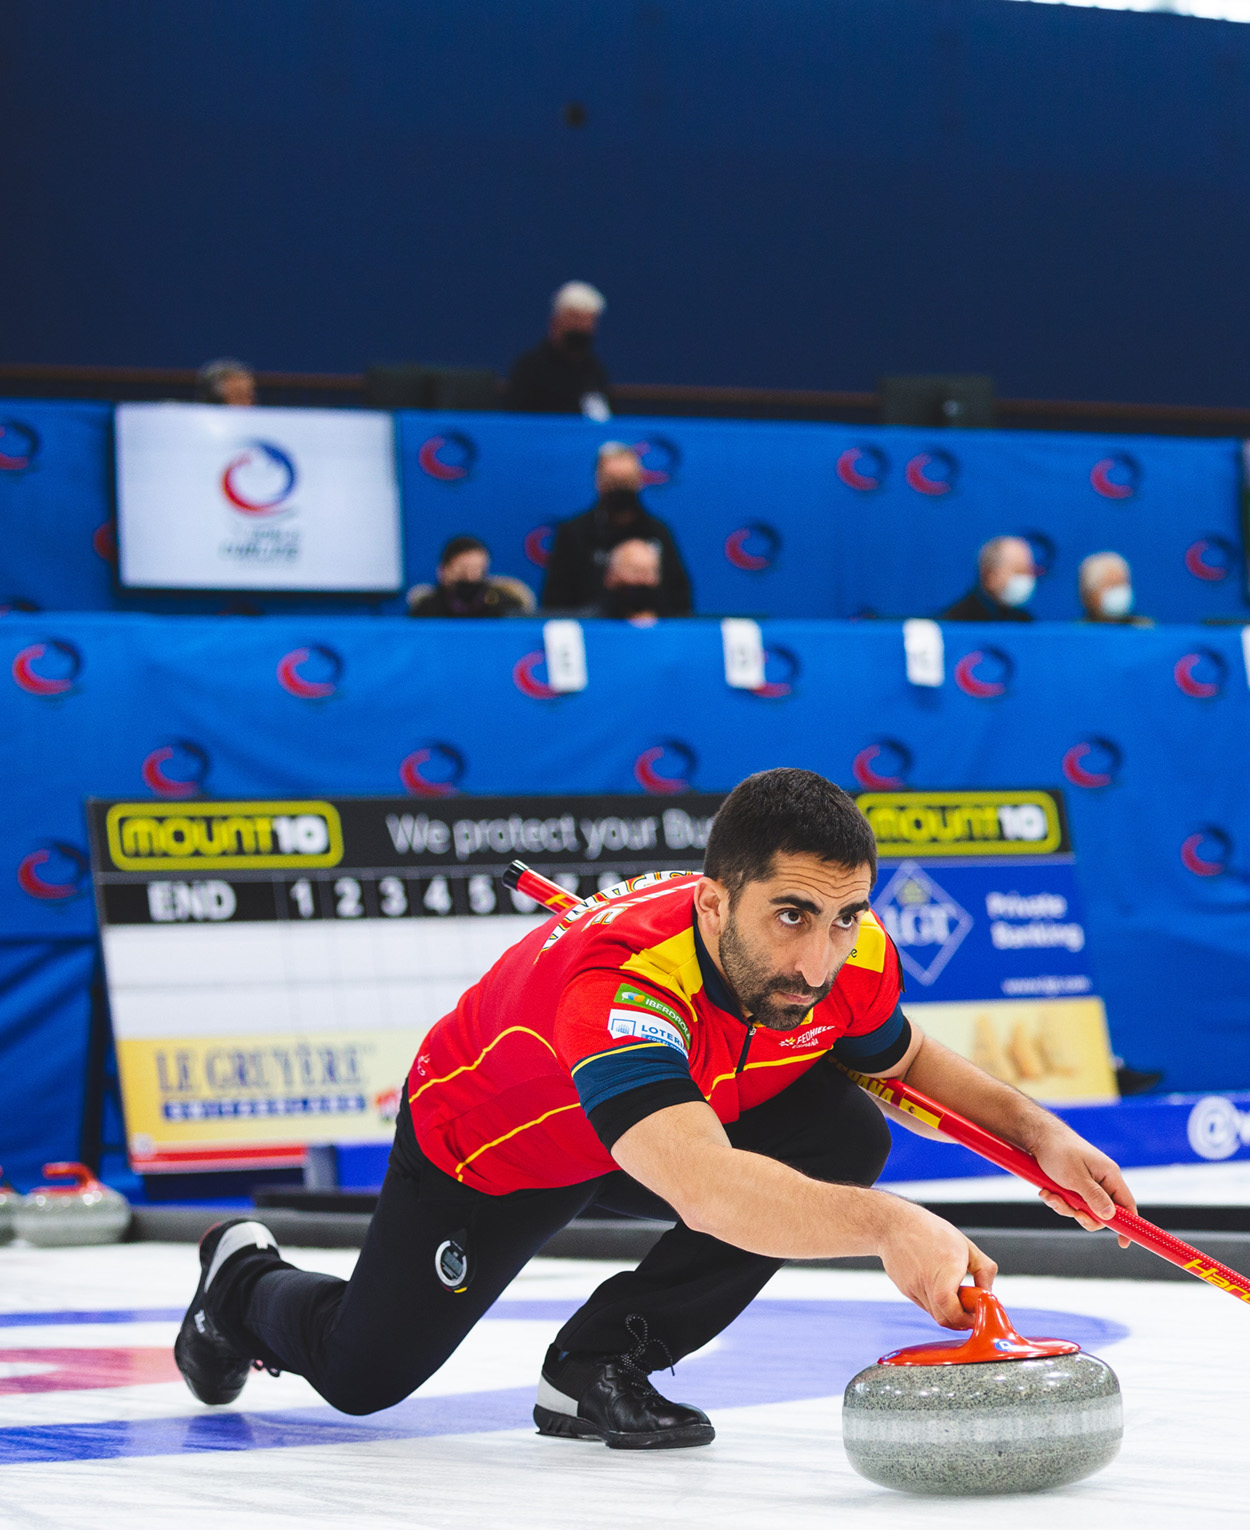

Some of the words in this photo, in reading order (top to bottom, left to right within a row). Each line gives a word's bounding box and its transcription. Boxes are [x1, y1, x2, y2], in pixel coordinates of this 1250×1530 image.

[121, 813, 329, 857] mount10
[384, 812, 451, 855] We
[453, 812, 582, 862] protect
[580, 816, 661, 861] your
[146, 878, 238, 922] END
[290, 876, 315, 920] 1
[333, 875, 364, 919] 2
[379, 874, 408, 918] 3
[423, 873, 453, 916] 4
[467, 872, 497, 915] 5
[154, 1047, 194, 1093] LE
